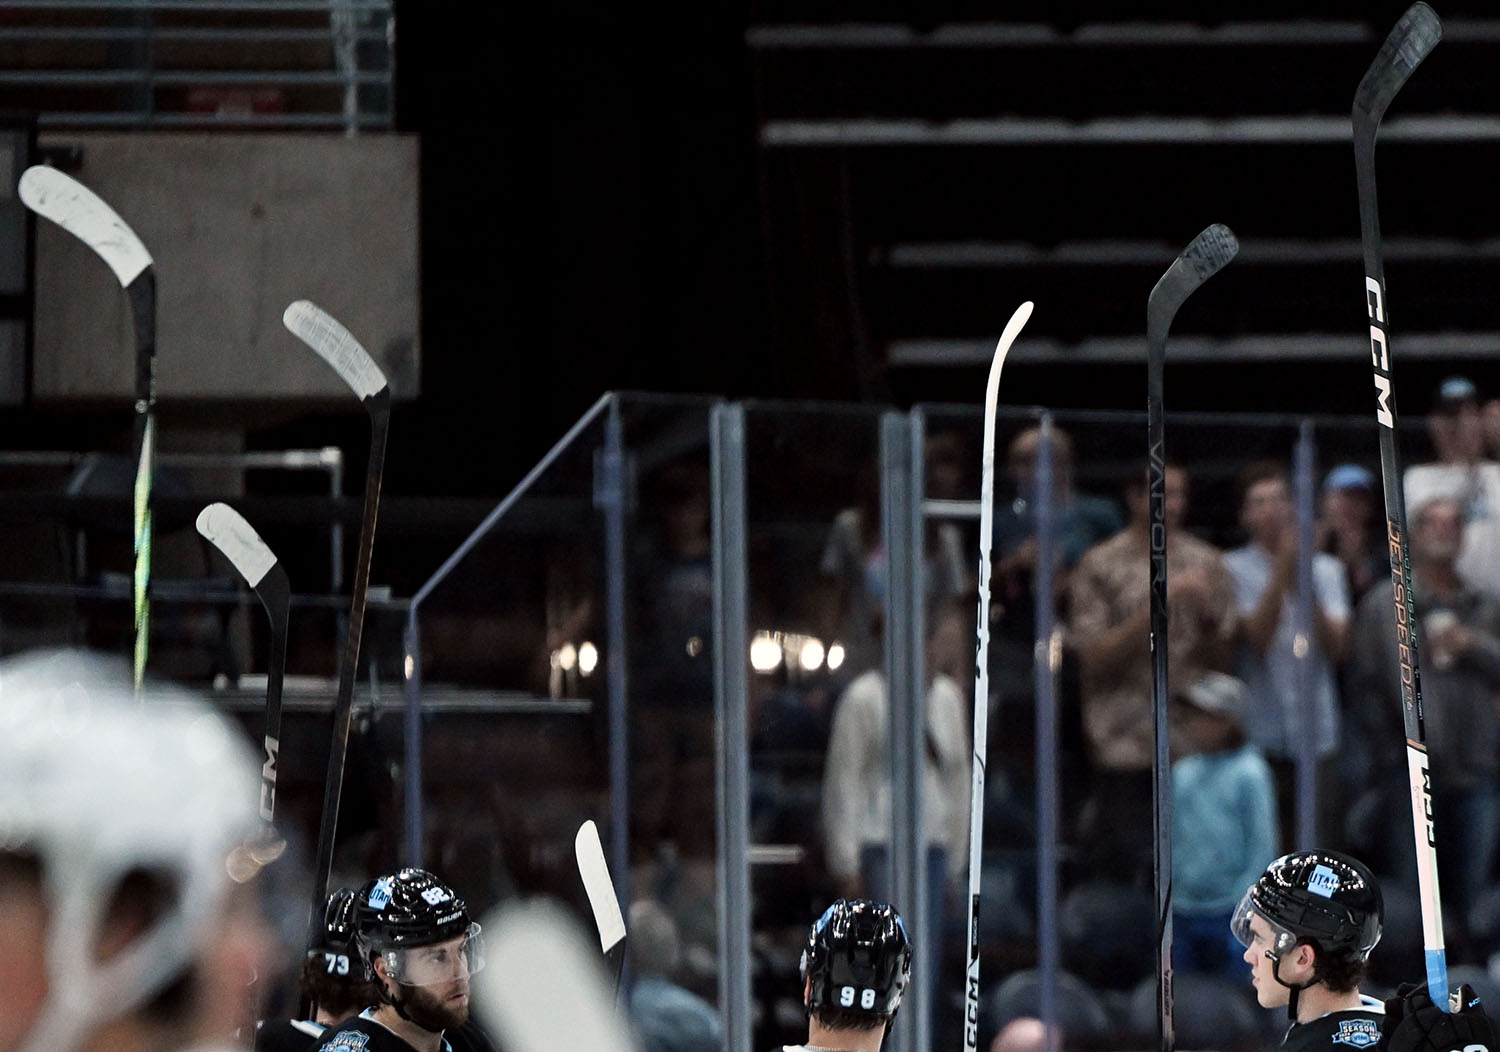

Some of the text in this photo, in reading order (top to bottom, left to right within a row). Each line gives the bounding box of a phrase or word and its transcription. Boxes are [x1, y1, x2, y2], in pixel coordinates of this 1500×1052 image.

[1366, 276, 1393, 428] CCM
[260, 735, 279, 822] CM
[325, 953, 349, 975] 73
[967, 976, 978, 1049] CCM
[1343, 1025, 1375, 1033] SEASON
